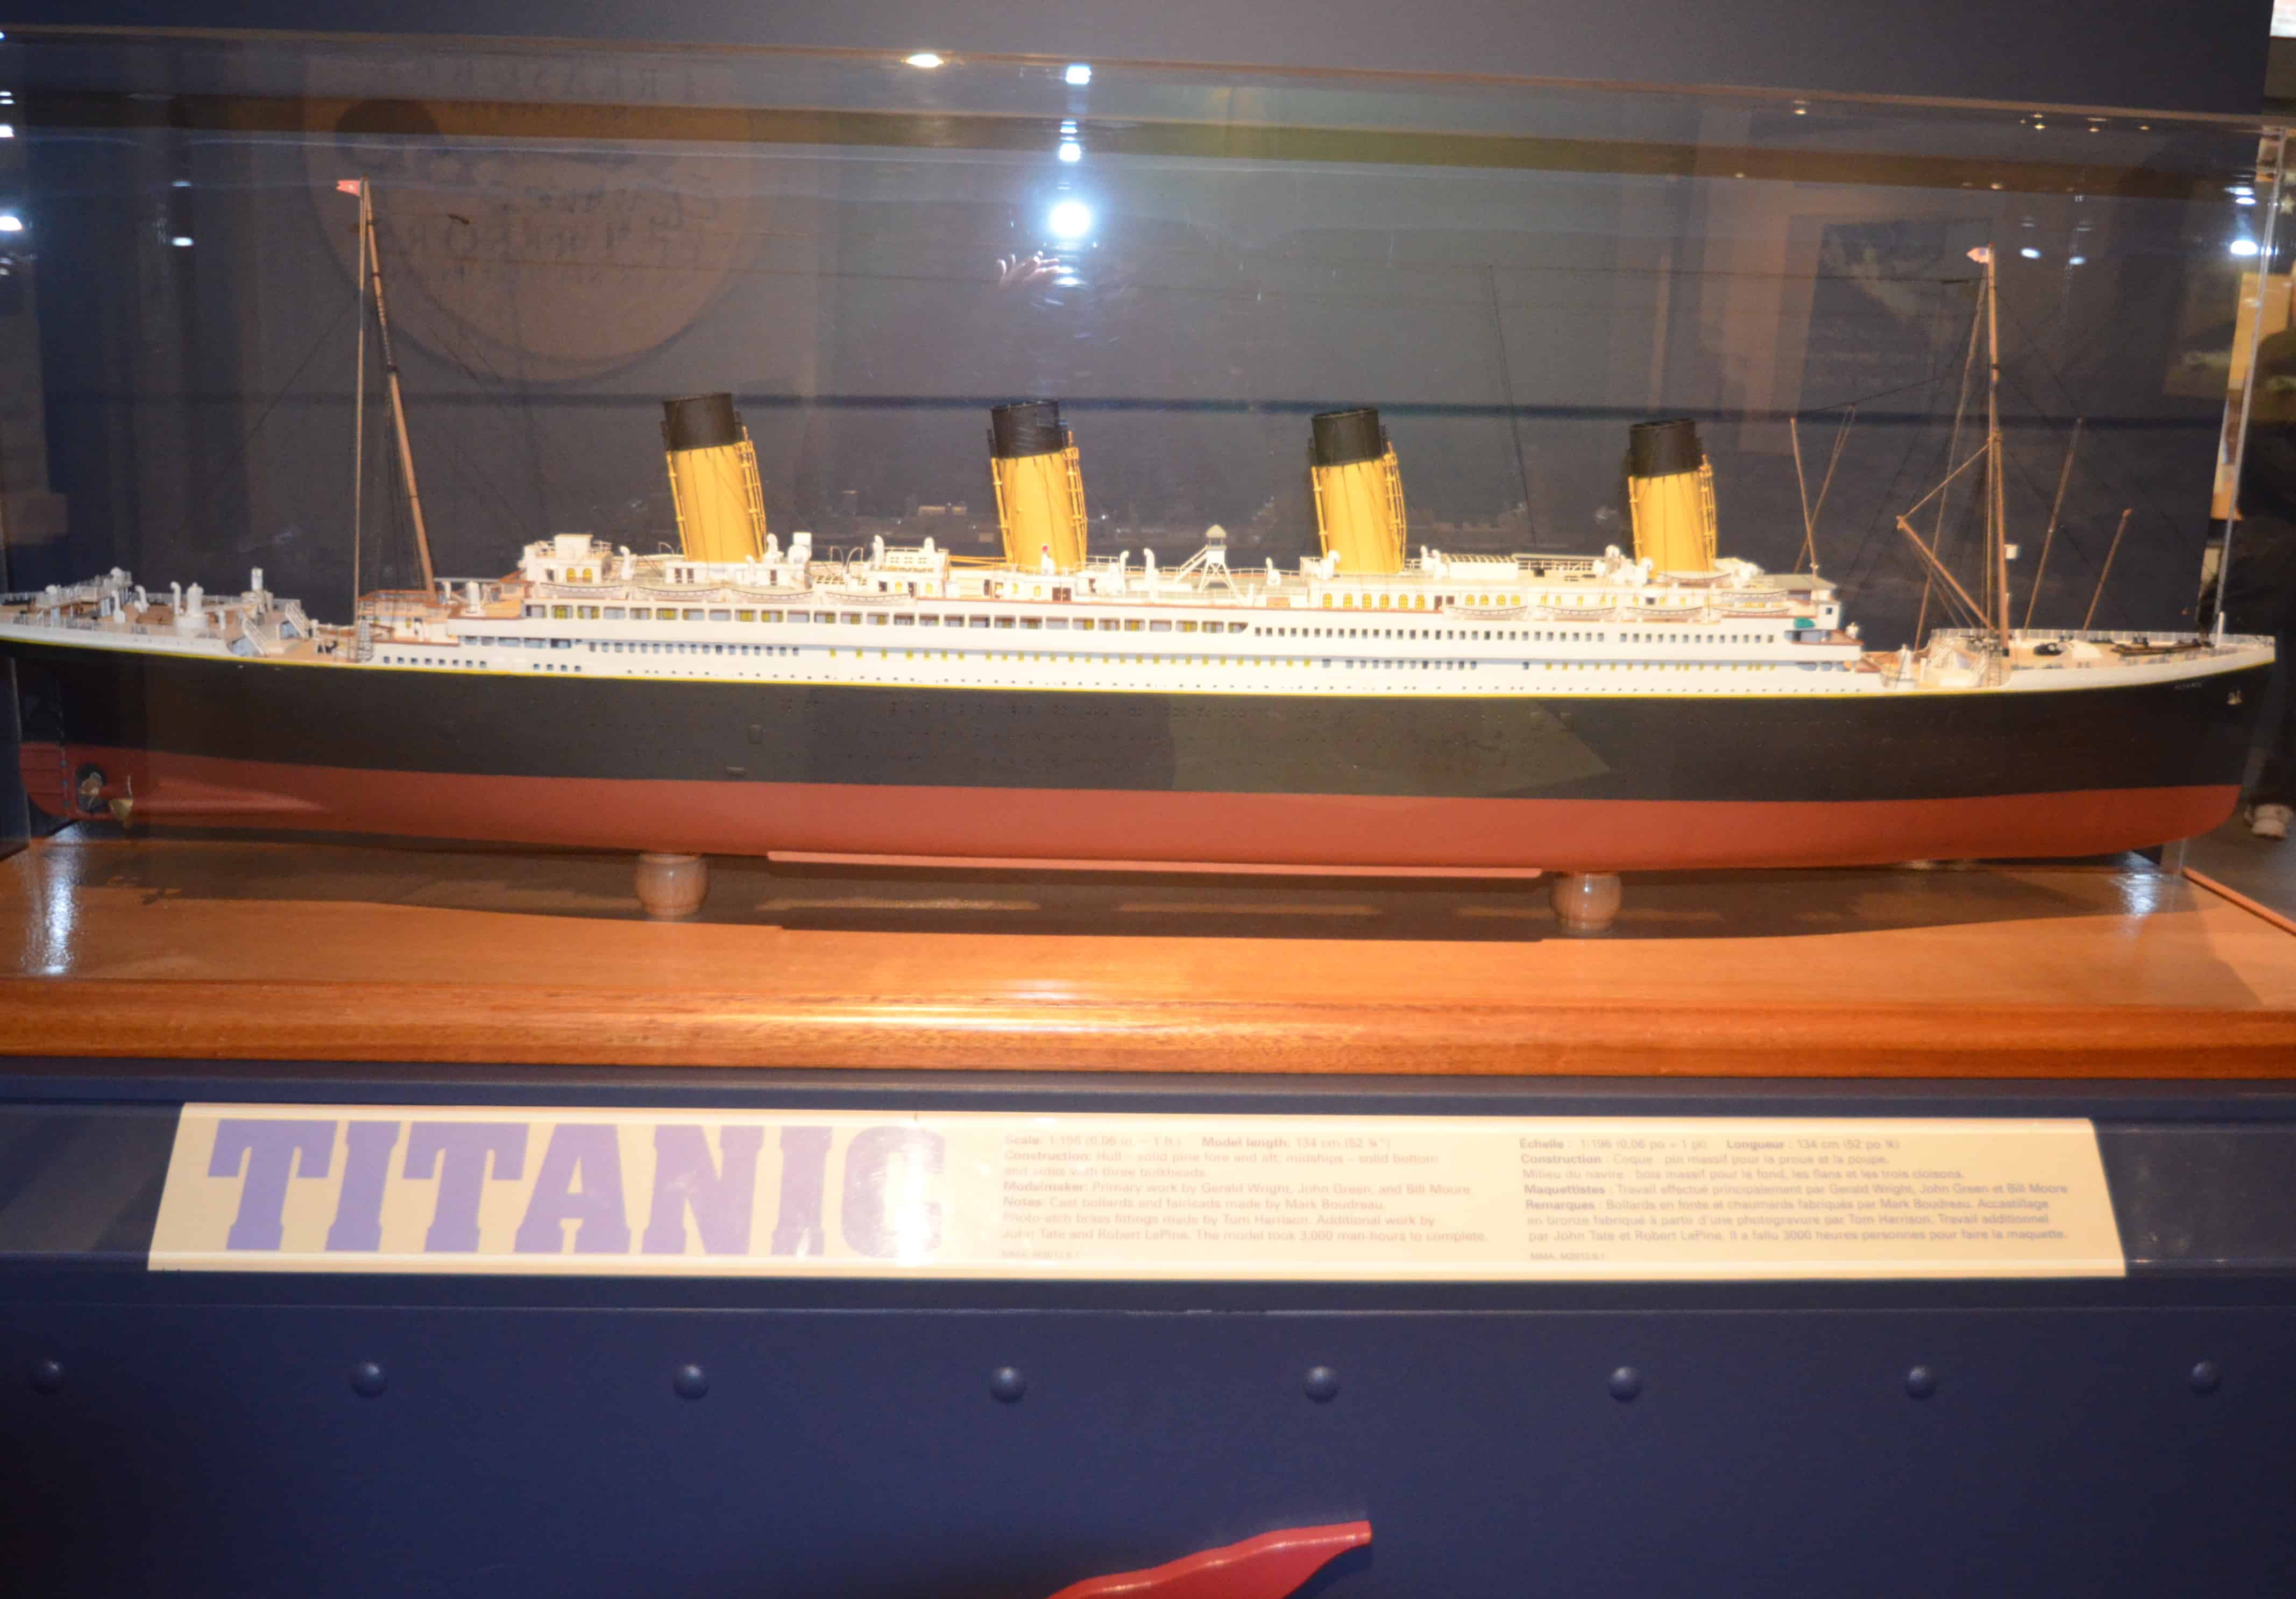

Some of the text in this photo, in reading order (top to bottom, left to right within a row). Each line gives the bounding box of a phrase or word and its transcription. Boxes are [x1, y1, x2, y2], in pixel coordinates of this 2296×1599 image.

[1201, 1136, 1242, 1147] Model
[1295, 1137, 1316, 1148] 134
[1321, 1140, 1341, 1148] cm
[1649, 1140, 1665, 1152] po
[1726, 1139, 1784, 1152] Longueur
[1797, 1139, 1817, 1149] 134
[1820, 1141, 1839, 1149] cm
[1865, 1140, 1881, 1151] po
[1004, 1149, 1093, 1162] Construction:
[1097, 1150, 1122, 1162] Hull
[1138, 1152, 1167, 1163] solid
[1173, 1153, 1200, 1165] pine
[1204, 1152, 1229, 1163] fore
[1234, 1153, 1257, 1163] and
[1286, 1153, 1343, 1166] midships
[1358, 1153, 1388, 1164] solid
[1393, 1153, 1439, 1164] bottom
[1521, 1153, 1601, 1164] Construction
[1613, 1153, 1653, 1166] Coque
[1688, 1153, 1727, 1164] massif
[1732, 1155, 1760, 1167] pour
[1764, 1154, 1775, 1164] la
[1778, 1156, 1813, 1166] proue
[1818, 1155, 1829, 1164] et
[1832, 1154, 1844, 1164] la
[1004, 1166, 1028, 1176] and
[1102, 1167, 1135, 1177] three
[1523, 1168, 1561, 1179] Milieu
[1565, 1169, 1581, 1179] du
[1585, 1168, 1624, 1179] navire
[1635, 1168, 1661, 1179] bois
[1666, 1168, 1704, 1179] massif
[1709, 1170, 1737, 1182] pour
[1741, 1169, 1752, 1179] le
[1792, 1169, 1810, 1180] les
[1846, 1169, 1856, 1179] et
[1861, 1169, 1878, 1179] les
[1881, 1169, 1909, 1179] trois
[208, 1119, 945, 1258] TITANIC
[1003, 1181, 1088, 1192] Modelmaker:
[1093, 1181, 1141, 1196] Primary
[1146, 1182, 1177, 1193] work
[1181, 1183, 1196, 1195] by
[1201, 1182, 1243, 1193] Gerald
[1298, 1183, 1329, 1194] John
[1379, 1184, 1401, 1195] and
[1406, 1183, 1425, 1195] Bill
[1429, 1184, 1471, 1196] Moore
[1524, 1184, 1605, 1196] Maquettistes
[1615, 1183, 1657, 1194] Travail
[1661, 1183, 1708, 1195] effectué
[1712, 1184, 1802, 1196] principalement
[1806, 1186, 1825, 1197] par
[1829, 1183, 1868, 1195] Gerald
[1919, 1183, 1949, 1195] John
[1952, 1183, 1989, 1195] Green
[1992, 1184, 2004, 1194] et
[2007, 1183, 2025, 1194] Bill
[2029, 1183, 2068, 1194] Moore
[1050, 1197, 1076, 1209] Cast
[1082, 1198, 1133, 1209] bollards
[1138, 1198, 1161, 1209] and
[1166, 1197, 1221, 1209] fairleads
[1226, 1198, 1260, 1210] made
[1265, 1199, 1280, 1212] by
[1285, 1198, 1317, 1210] Mark
[1525, 1199, 1595, 1212] Remarques
[1606, 1199, 1656, 1210] Bollards
[1660, 1201, 1674, 1210] en
[1678, 1199, 1709, 1210] fonte
[1713, 1200, 1724, 1210] et
[1727, 1199, 1794, 1210] chaumards
[1797, 1198, 1853, 1212] fabriqués
[1858, 1200, 1875, 1212] par
[1880, 1198, 1909, 1210] Mark
[1978, 1198, 2049, 1211] Accastillage
[1076, 1213, 1110, 1224] brass
[1115, 1213, 1158, 1226] fittings
[1163, 1213, 1199, 1225] made
[1203, 1214, 1218, 1226] by
[1222, 1213, 1250, 1225] Tom
[1316, 1214, 1380, 1226] Additional
[1385, 1214, 1415, 1226] work
[1420, 1214, 1435, 1228] by
[1527, 1216, 1542, 1226] en
[1547, 1214, 1589, 1226] bronze
[1594, 1213, 1645, 1227] fabriqué
[1661, 1214, 1693, 1227] partir
[1737, 1214, 1819, 1227] photogravure
[1824, 1216, 1844, 1227] par
[1847, 1213, 1873, 1225] Tom
[1938, 1213, 1977, 1225] Travail
[1981, 1213, 2049, 1224] additionnel
[1001, 1228, 1034, 1240] John
[1039, 1228, 1066, 1239] Tate
[1068, 1229, 1093, 1240] and
[1098, 1228, 1140, 1240] Robert
[1196, 1229, 1219, 1241] The
[1224, 1229, 1263, 1241] model
[1268, 1230, 1295, 1241] took
[1410, 1231, 1422, 1242] to
[1528, 1231, 1548, 1243] par
[1553, 1230, 1584, 1241] John
[1589, 1230, 1614, 1241] Tate
[1619, 1231, 1631, 1241] et
[1635, 1230, 1676, 1242] Robert
[1730, 1230, 1737, 1240] Il
[1752, 1230, 1778, 1241] fallu
[1782, 1230, 1811, 1241] 3000
[1816, 1230, 1858, 1241] heures
[1862, 1230, 1925, 1243] personnes
[1929, 1230, 1957, 1242] pour
[1961, 1228, 1988, 1240] faire
[1992, 1228, 2003, 1240] la
